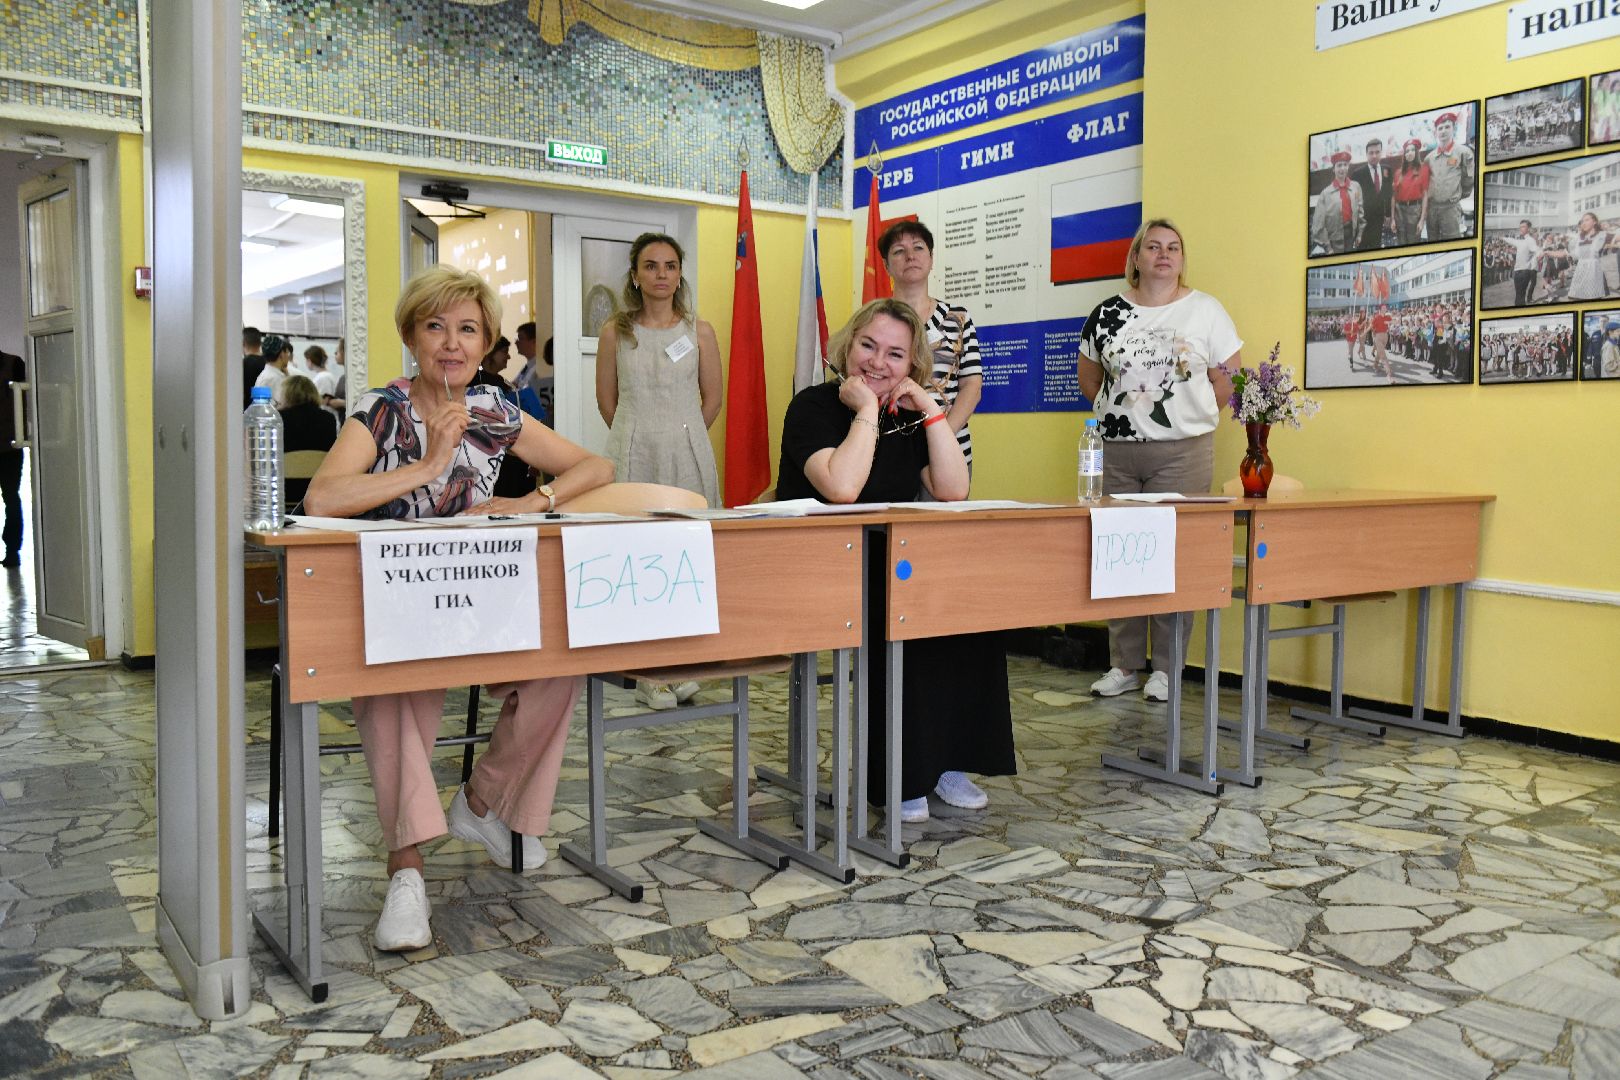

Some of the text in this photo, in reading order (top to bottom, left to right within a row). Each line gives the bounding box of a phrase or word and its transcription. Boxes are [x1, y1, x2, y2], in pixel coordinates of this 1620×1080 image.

[880, 36, 1120, 125] ГОСУДАРСТВЕННЫЕ СИМВОЛЫ
[891, 64, 1101, 140] РОССИЙСКОЙ ФЕДЕРАЦИИ
[1066, 111, 1130, 144] ФЛАГ
[553, 143, 603, 164] ВЫХОД
[960, 141, 1015, 170] ГИМН
[380, 539, 523, 559] РЕГИСТРАЦИЯ
[1095, 531, 1157, 576] ПРОФ
[384, 564, 520, 585] УЧАСТНИКОВ
[568, 549, 705, 609] БАЗА
[434, 594, 474, 610] ГИА
